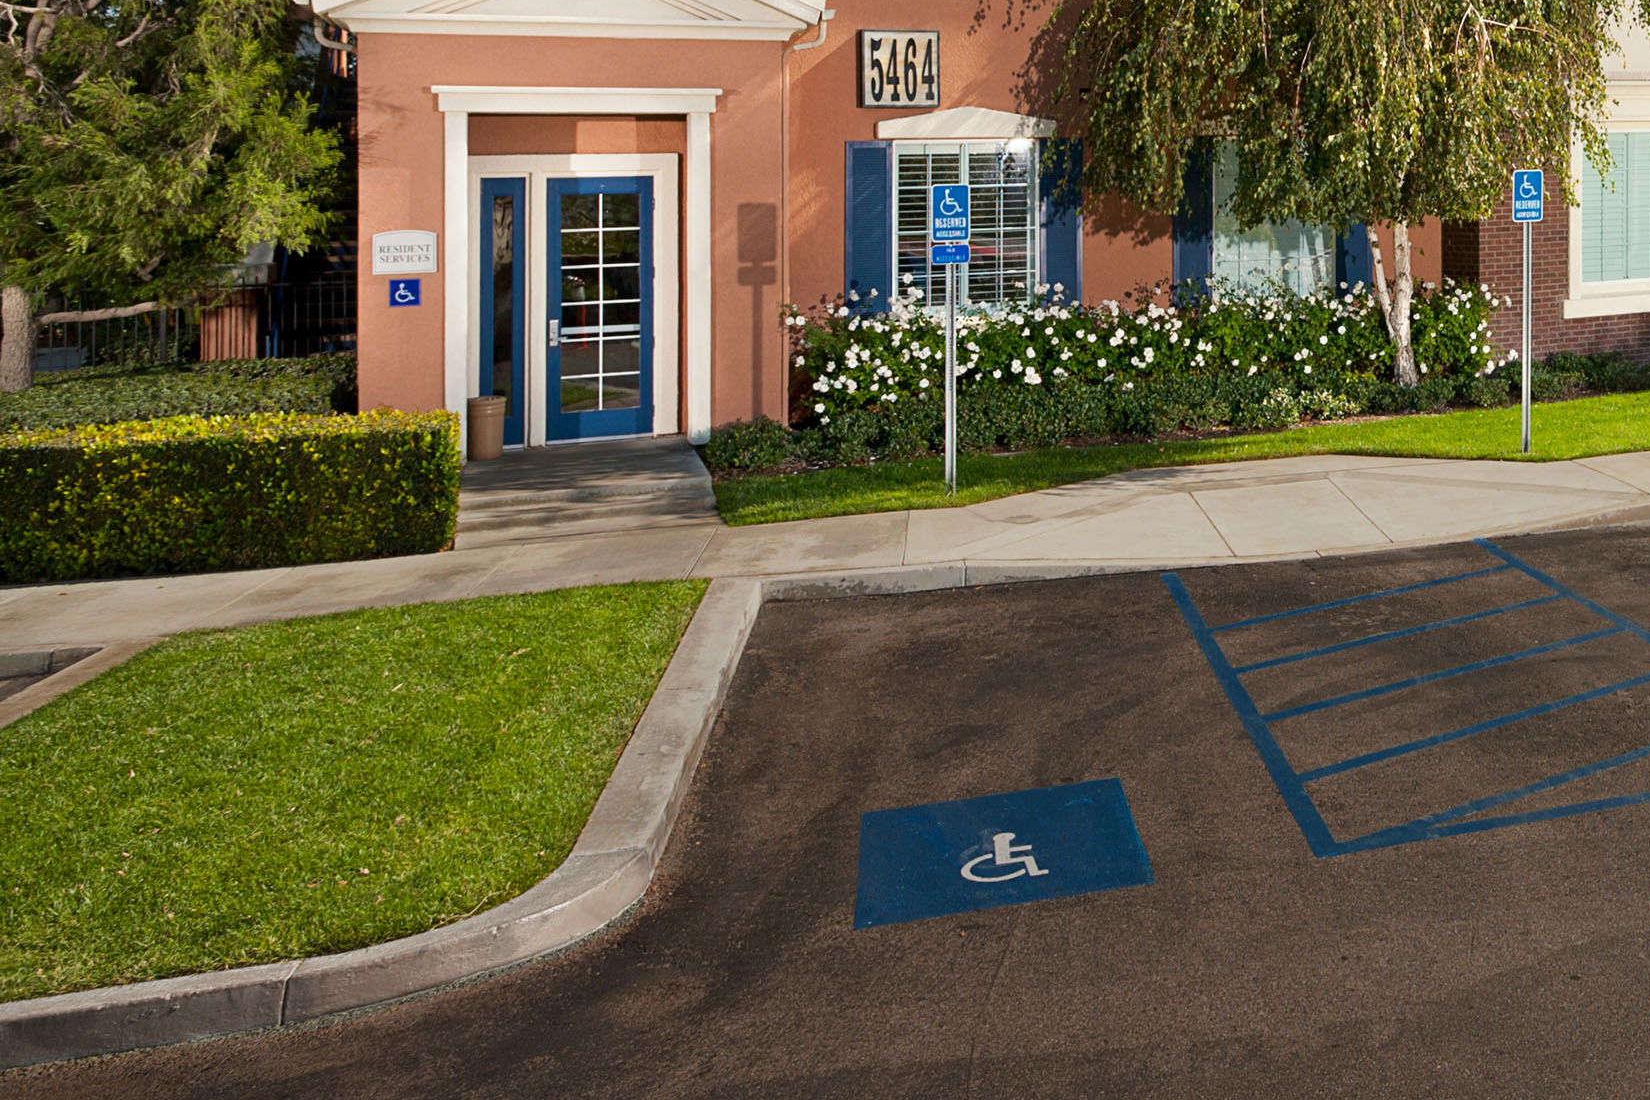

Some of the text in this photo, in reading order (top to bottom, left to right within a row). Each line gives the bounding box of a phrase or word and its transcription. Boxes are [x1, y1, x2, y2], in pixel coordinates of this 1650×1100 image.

[870, 37, 935, 102] 5464
[935, 217, 967, 228] RESERVED
[379, 244, 431, 254] RESIDENT
[379, 253, 431, 264] SERVICES
